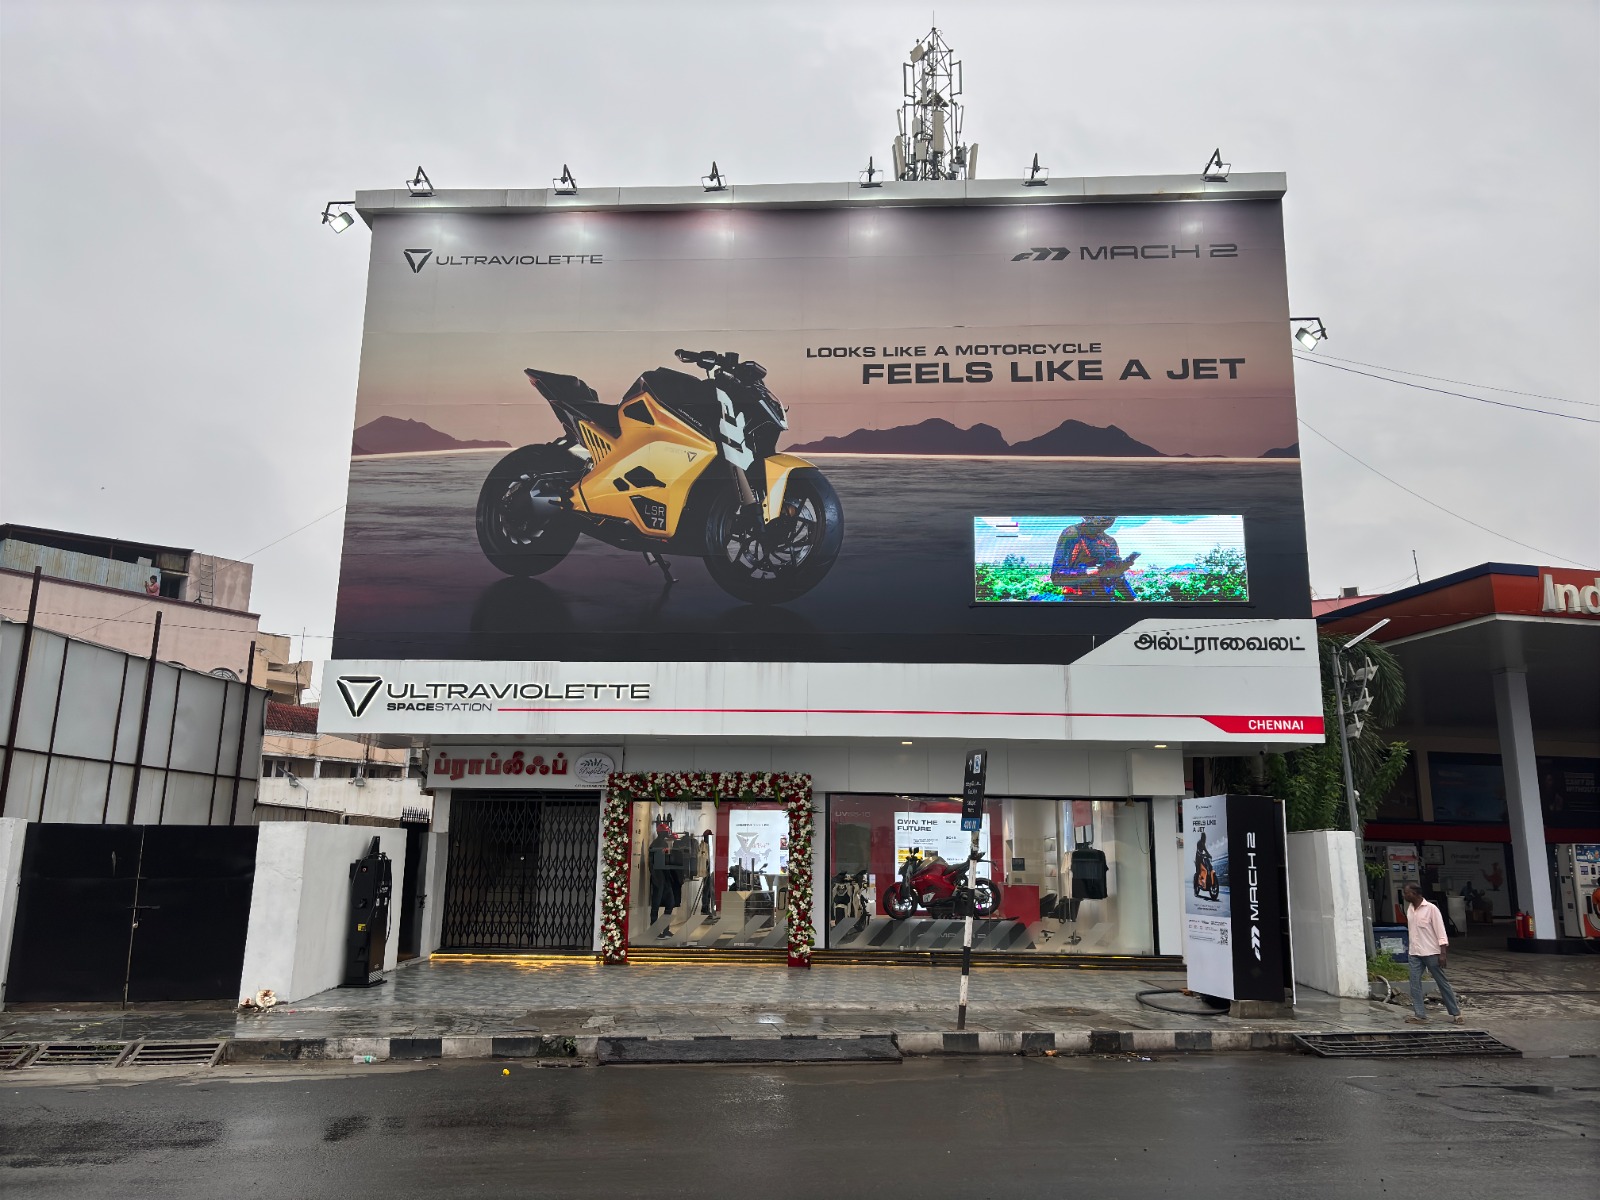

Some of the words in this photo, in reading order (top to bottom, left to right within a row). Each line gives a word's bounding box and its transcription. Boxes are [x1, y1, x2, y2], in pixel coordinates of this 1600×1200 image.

[436, 254, 603, 266] ULTRAVIOLETTE
[1079, 244, 1200, 261] MACH
[1209, 243, 1239, 258] 2
[806, 347, 876, 359] LOOKS
[882, 346, 927, 357] LIKE
[934, 345, 949, 356] A
[955, 343, 1102, 356] MOTORCYCLE
[862, 361, 993, 385] FEELS
[1010, 359, 1103, 382] LIKE
[1119, 359, 1152, 380] A
[1167, 357, 1246, 379] JET
[644, 505, 665, 516] LSR
[651, 517, 665, 528] 77
[1133, 632, 1306, 654] அல்ட்ராவைலட்
[387, 683, 651, 700] ULTRAVIOLETTE
[386, 702, 493, 712] SPACESTATION
[1248, 719, 1305, 731] CHENNAI
[433, 750, 568, 781] ப்ராப்லீஃப்
[1247, 832, 1257, 849] 2
[1247, 853, 1260, 921] MACH
